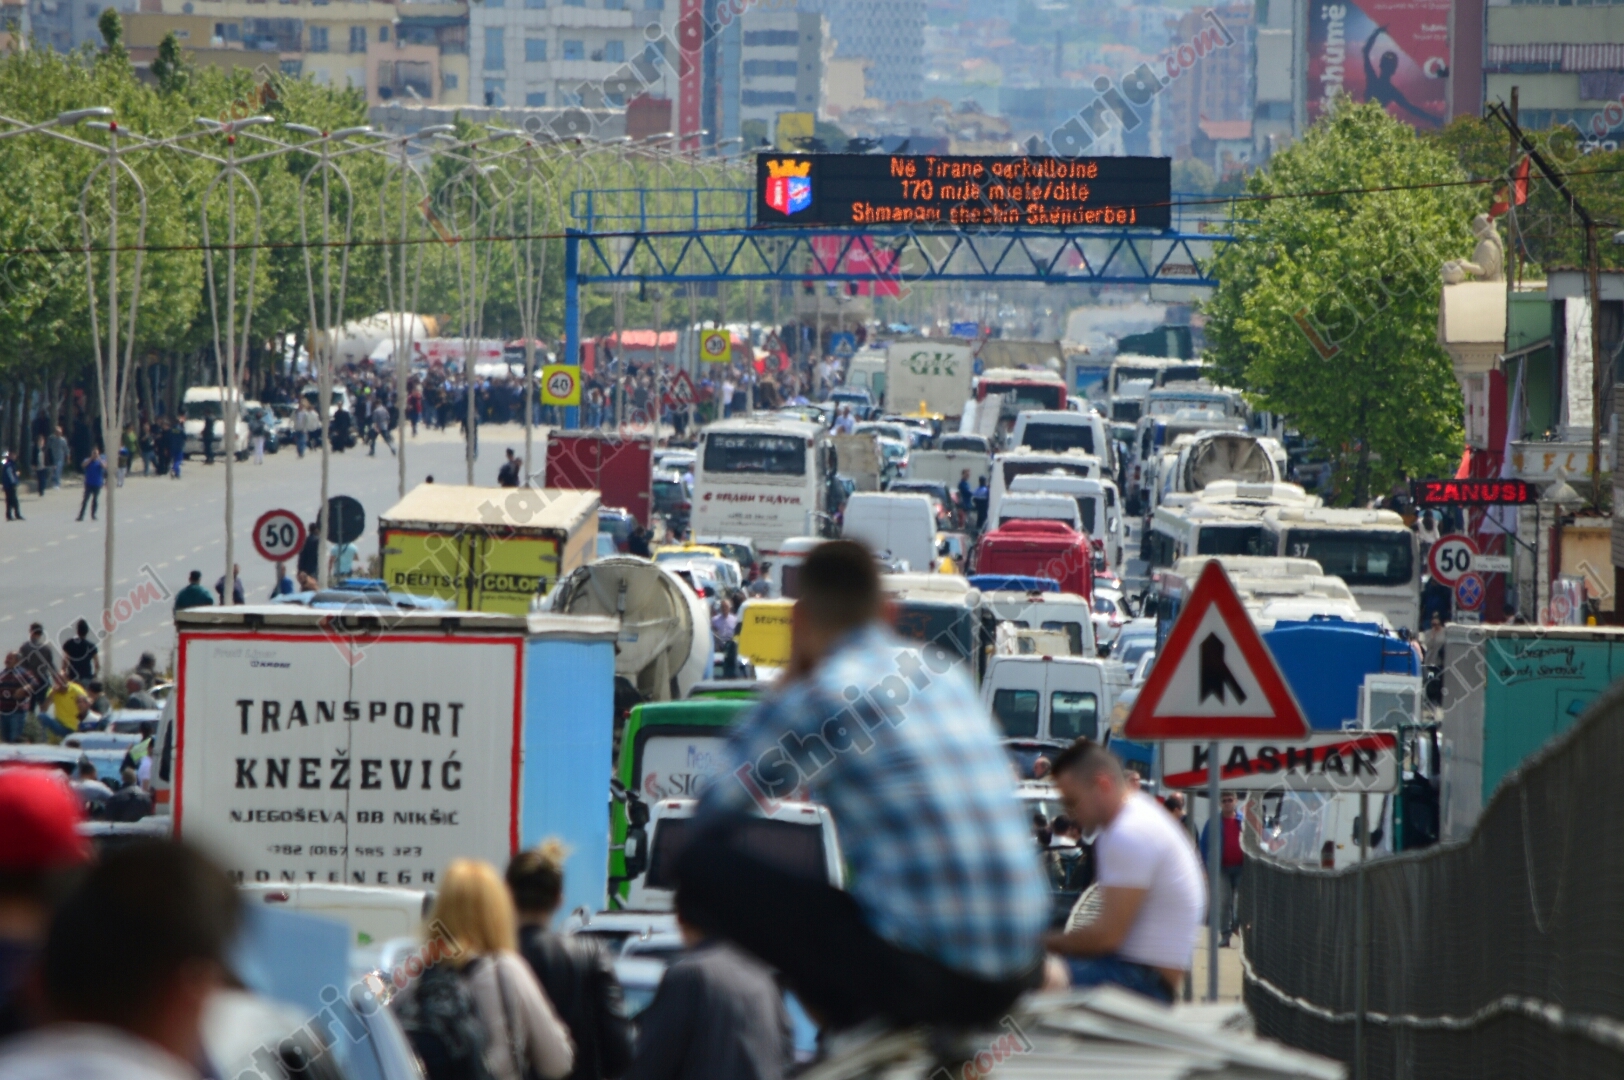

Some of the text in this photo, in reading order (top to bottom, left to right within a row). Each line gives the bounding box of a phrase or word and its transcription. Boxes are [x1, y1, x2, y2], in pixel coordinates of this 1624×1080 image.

[891, 157, 916, 177] Në
[925, 157, 984, 178] Tiranë
[901, 179, 933, 200] 170
[910, 351, 955, 376] GK
[551, 378, 569, 392] 40
[1425, 482, 1527, 502] ZANUSI
[265, 523, 295, 548] 50
[1440, 547, 1471, 572] 50
[236, 699, 464, 737] TRANSPORT
[235, 748, 462, 791] KNEŽEVIĆ
[1192, 745, 1378, 777] KASHAR
[229, 808, 347, 824] NJEGOŠEVA
[356, 811, 384, 825] BB
[226, 869, 436, 885] MONTENEGR
